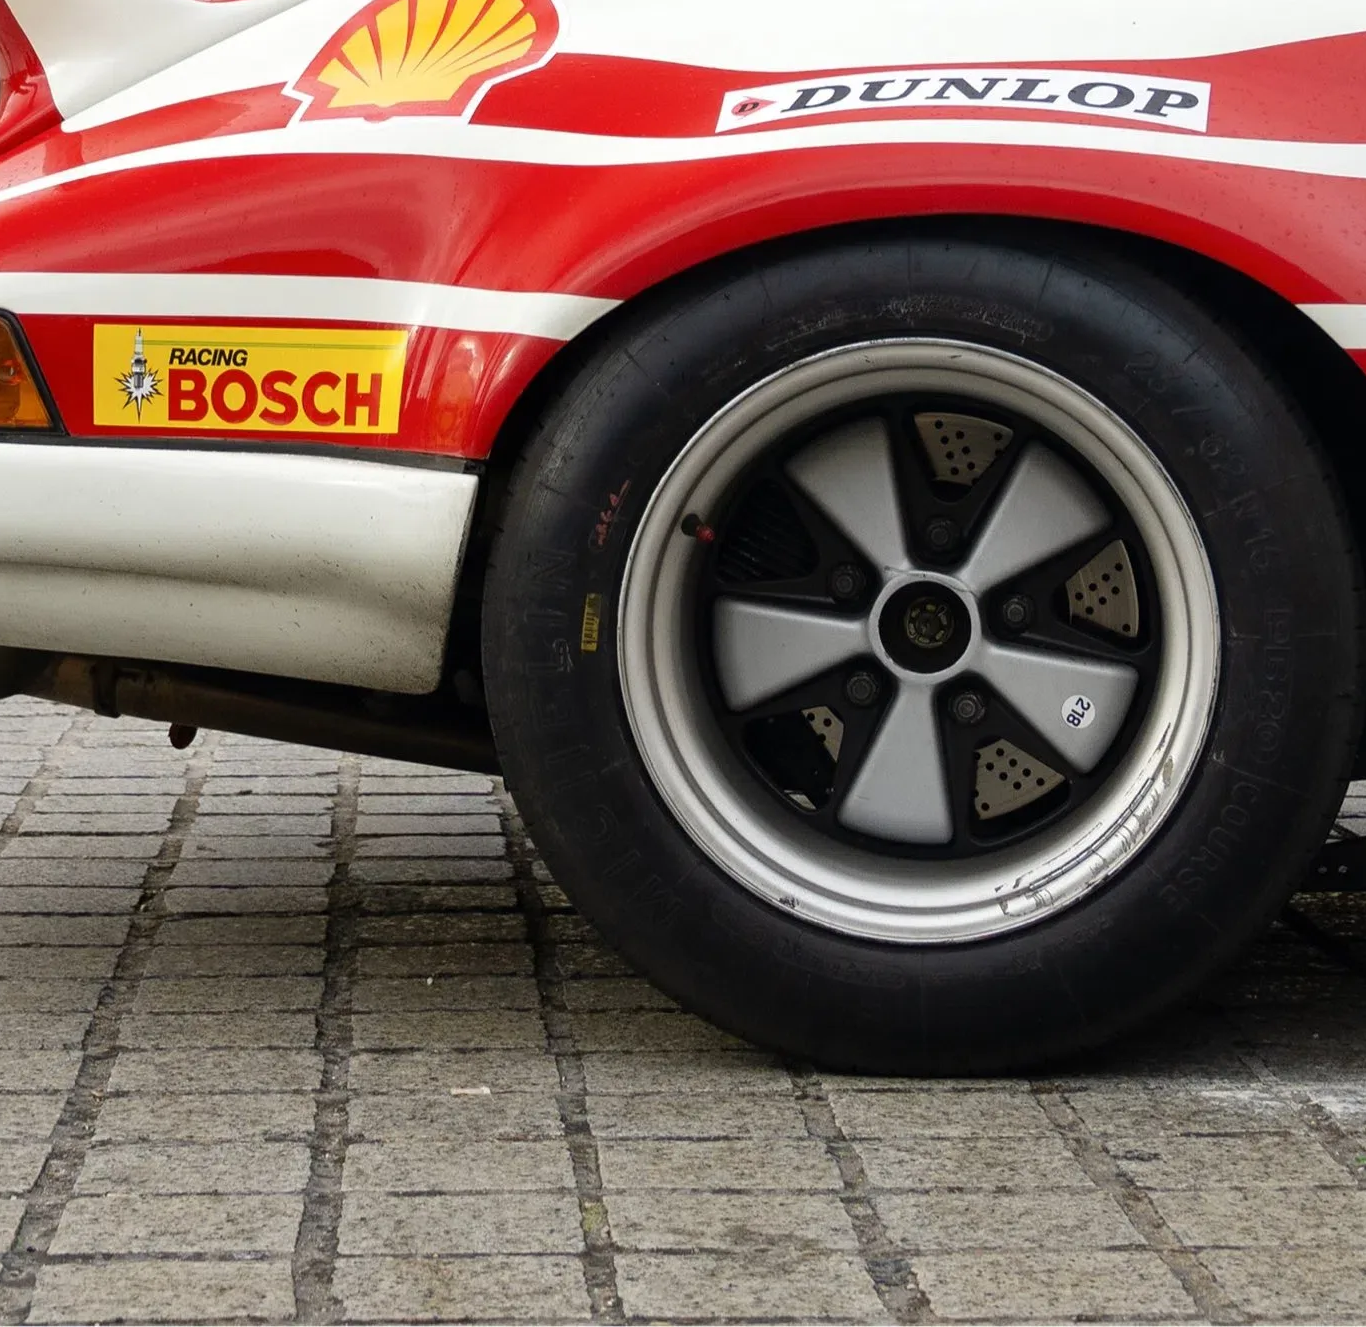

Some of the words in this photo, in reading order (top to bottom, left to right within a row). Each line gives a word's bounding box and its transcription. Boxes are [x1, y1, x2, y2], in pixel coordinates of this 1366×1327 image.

[781, 77, 1199, 117] DUNLOP
[169, 348, 248, 367] RACING
[168, 368, 382, 427] BOSCH
[1066, 697, 1091, 727] 218
